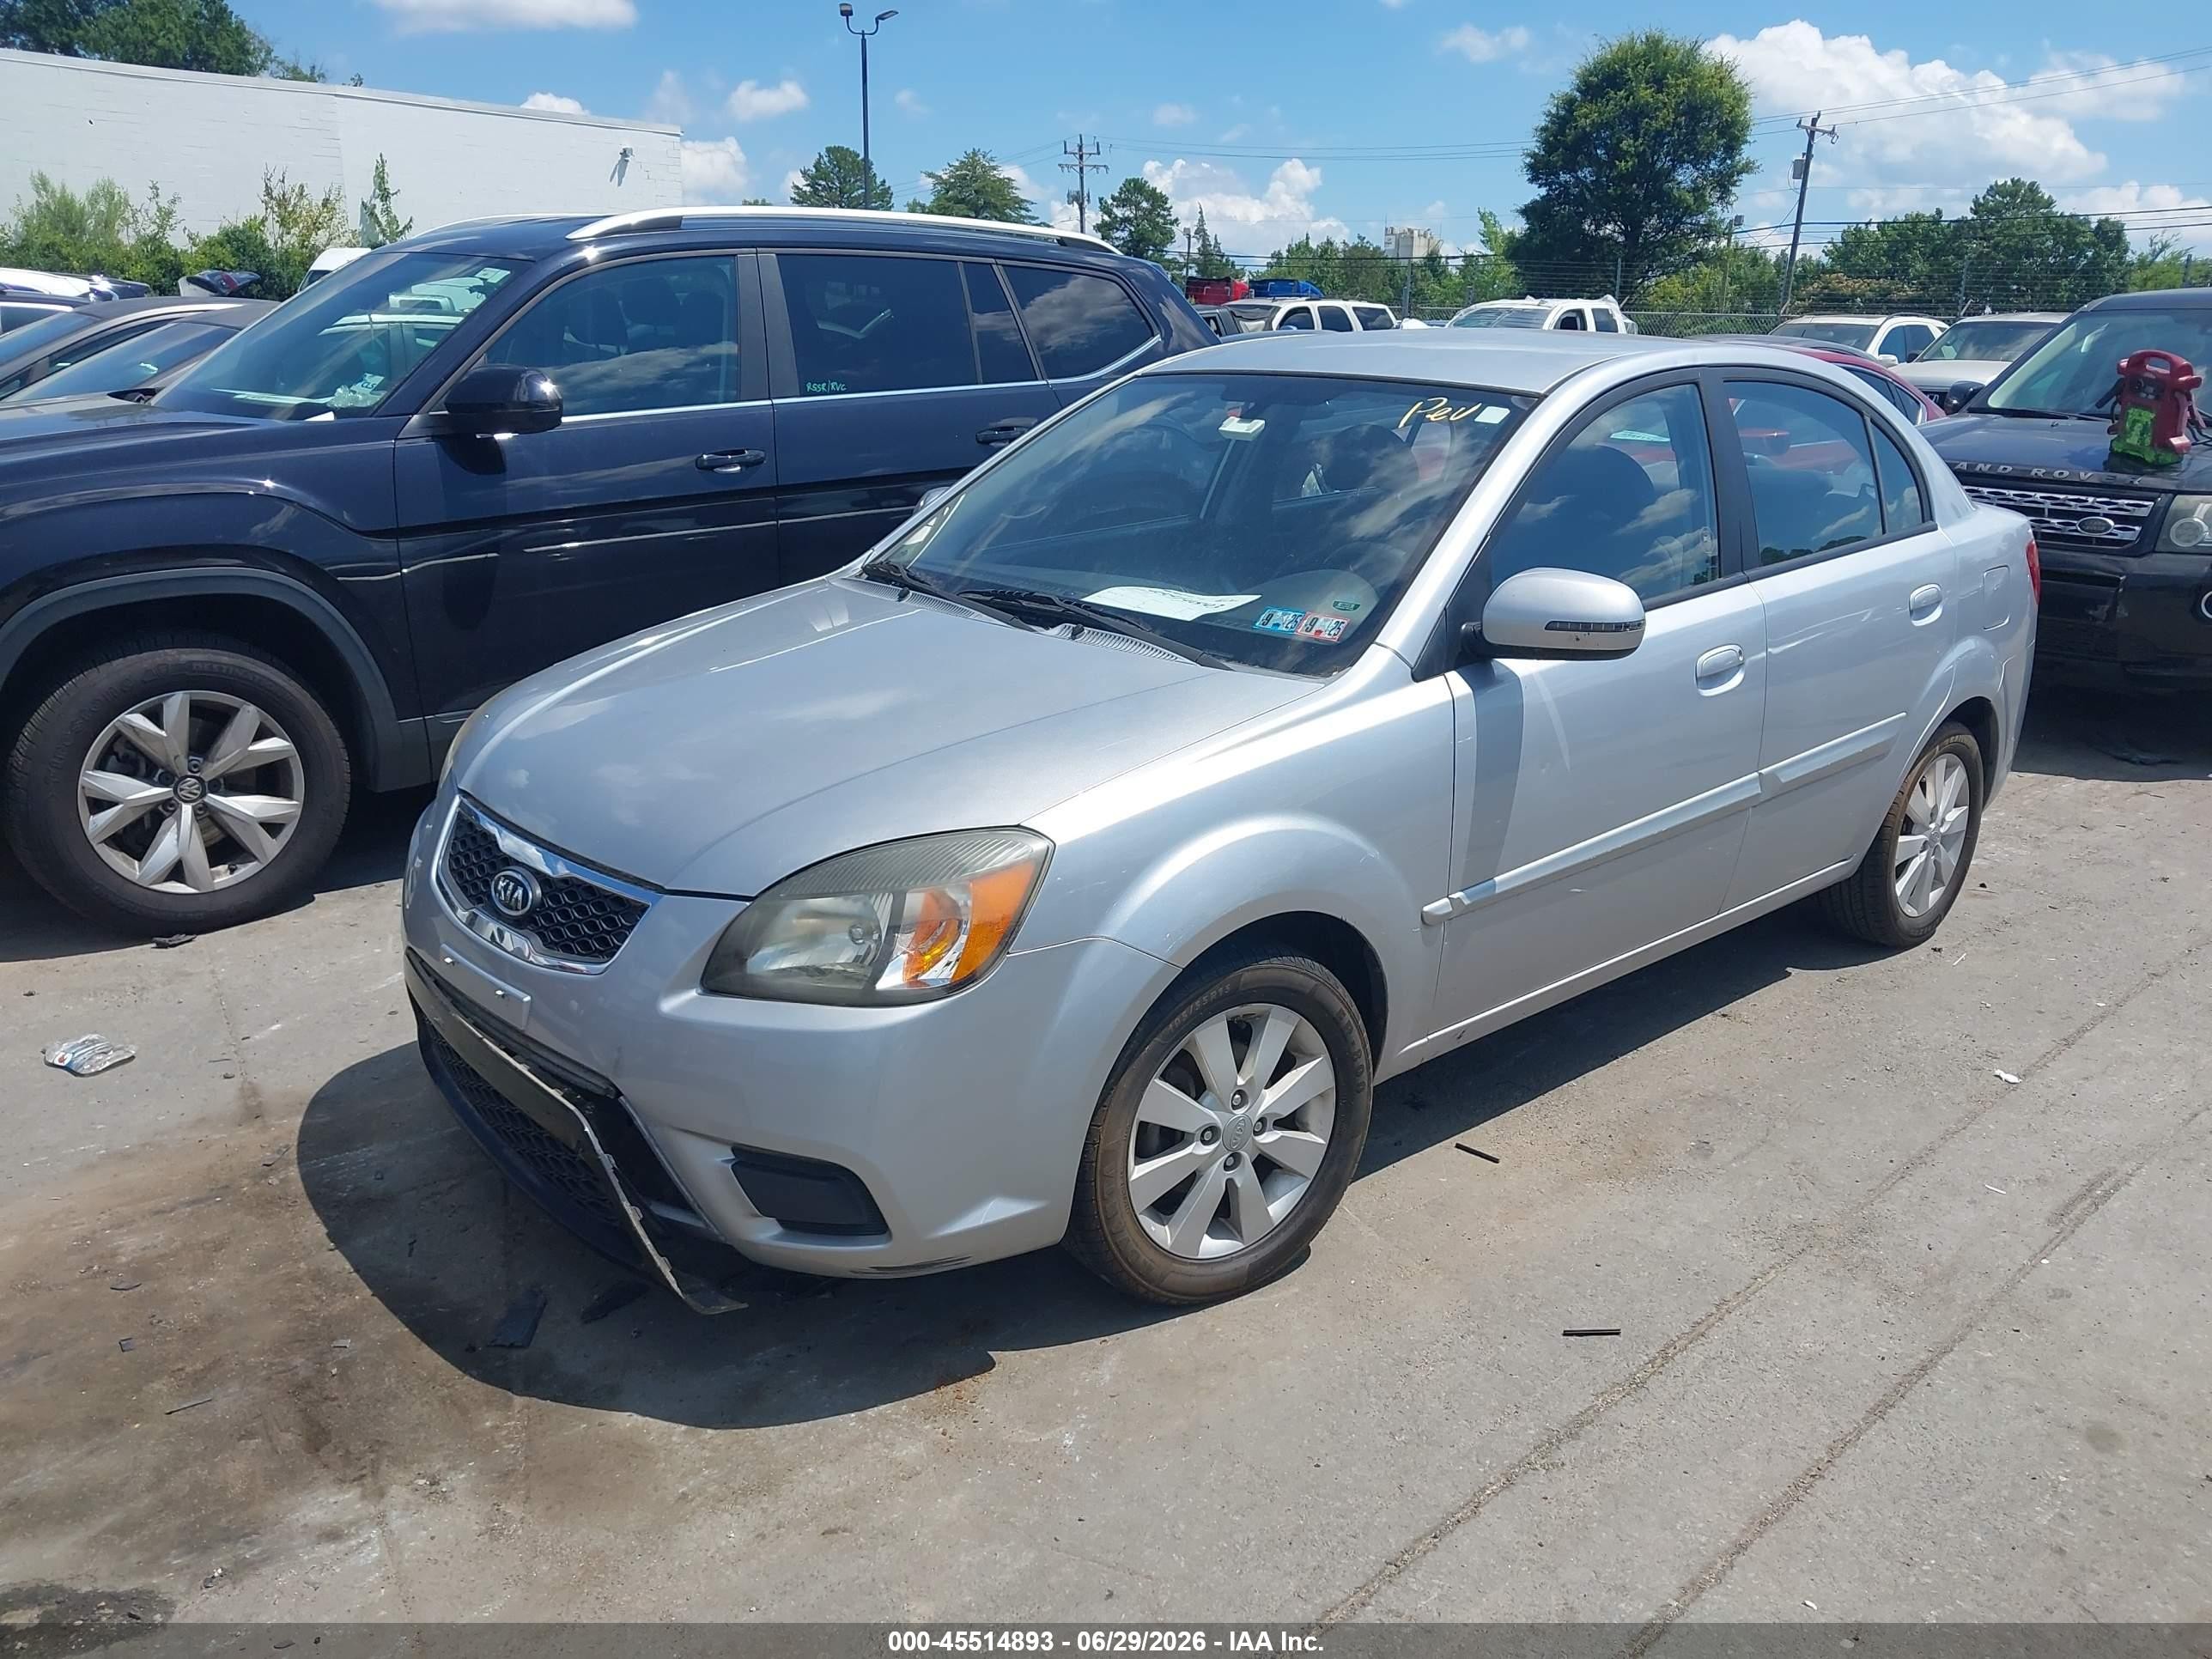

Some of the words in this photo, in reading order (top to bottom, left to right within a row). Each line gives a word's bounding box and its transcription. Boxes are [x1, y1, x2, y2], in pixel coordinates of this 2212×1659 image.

[1954, 461, 2014, 474] AND
[2030, 468, 2143, 485] ROVER
[1261, 612, 1273, 626] 9
[1285, 613, 1303, 629] 25
[1305, 617, 1319, 633] 9
[1327, 619, 1345, 637] 25
[497, 876, 524, 910] KIA
